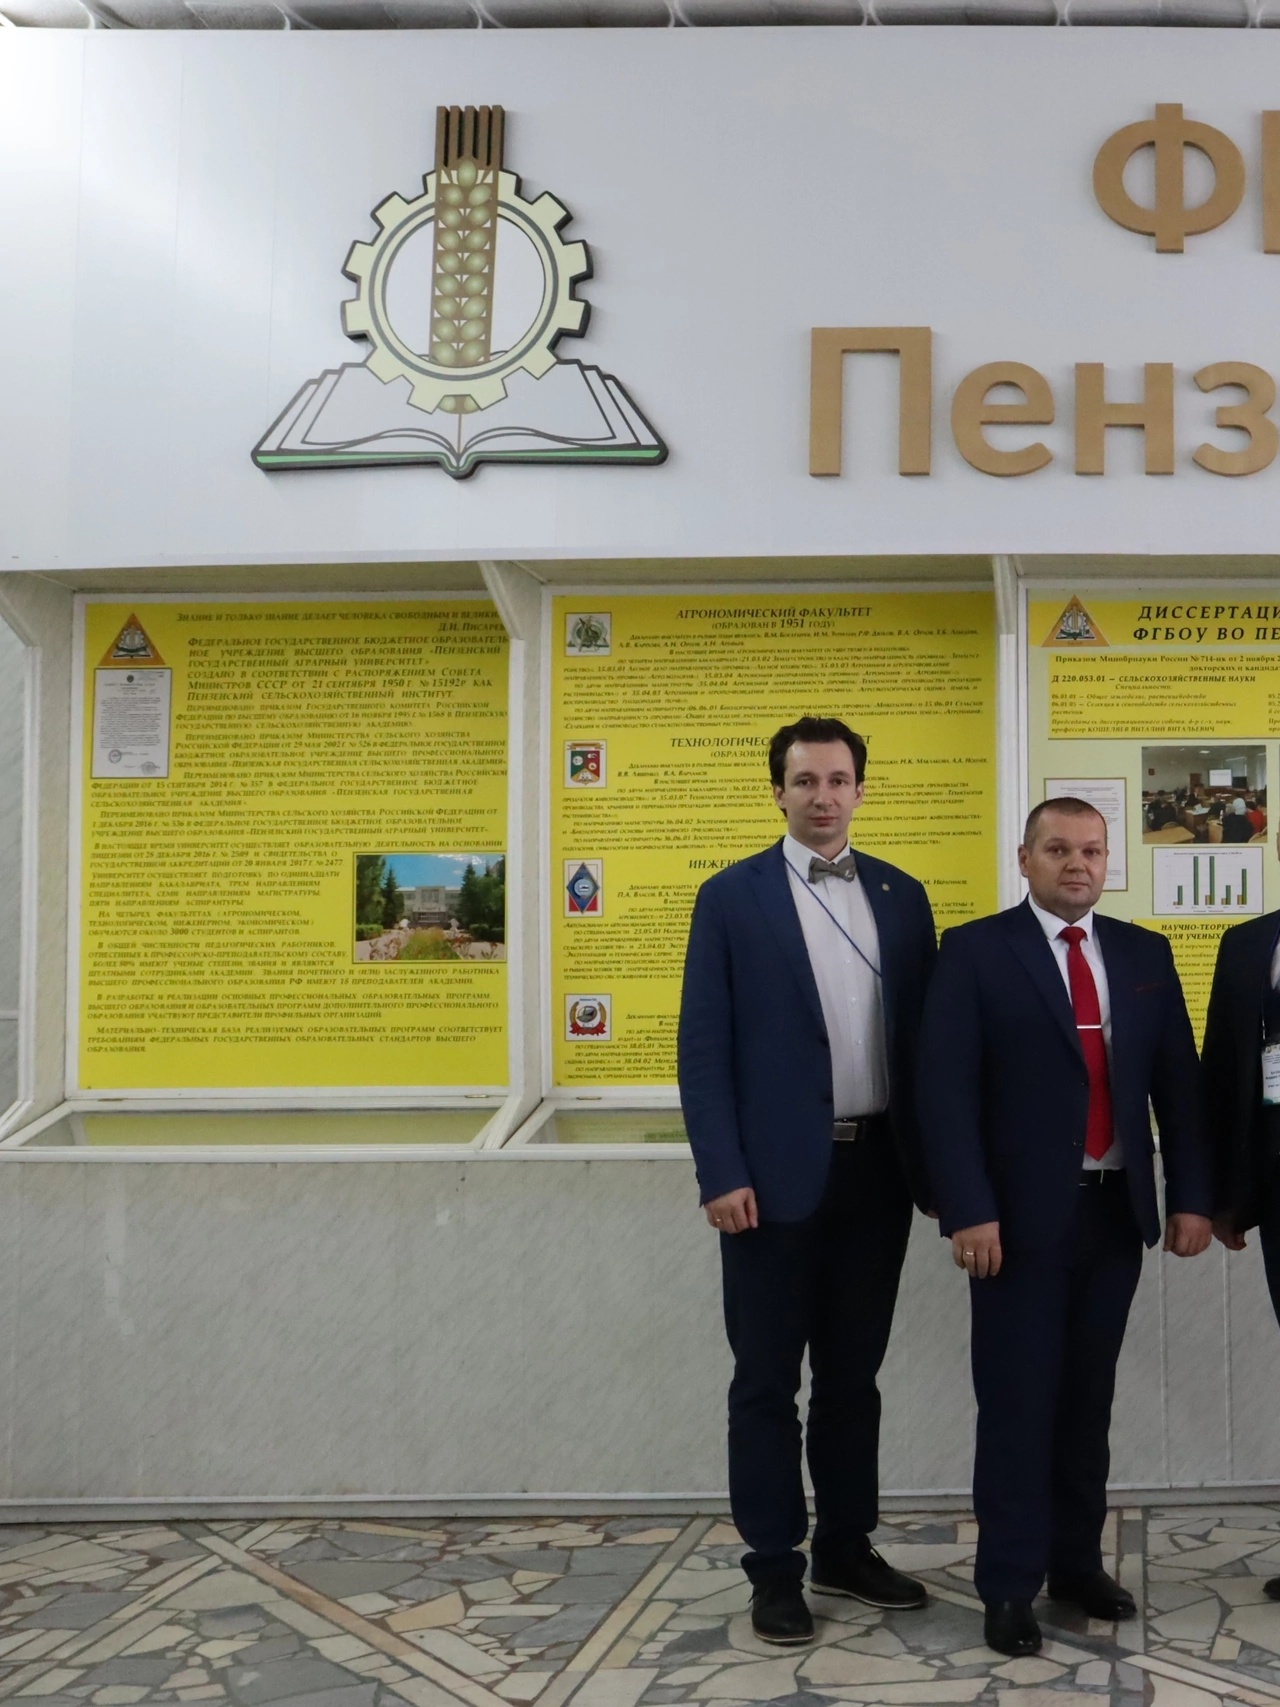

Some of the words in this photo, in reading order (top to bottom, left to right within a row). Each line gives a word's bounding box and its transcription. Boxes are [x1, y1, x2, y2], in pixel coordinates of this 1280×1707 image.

[677, 607, 796, 619] АГРОНОМИЧЕСКИЙ
[799, 607, 872, 618] ФАКУЛЬТЕТ
[781, 619, 804, 628] 1951
[1133, 627, 1207, 643] ФГБОУ
[1217, 627, 1244, 640] ВО
[188, 637, 261, 646] ФЕДЕРАЛЬНОЕ
[265, 637, 360, 646] ГОСУДАРСТВЕННОЕ
[364, 636, 428, 645] БЮДЖЕТНОЕ
[189, 649, 209, 658] НОЕ
[221, 648, 284, 657] УЧРЕЖДЕНИЕ
[294, 647, 343, 656] ВЫСШЕГО
[351, 646, 422, 656] ОБРАЗОВАНИЯ
[189, 659, 288, 668] ГОСУДАРСТВЕННЫЙ
[295, 658, 347, 667] АГРАРНЫЙ
[1056, 655, 1096, 664] Приказом
[1100, 655, 1157, 663] Минобрнауки
[1161, 655, 1188, 663] России
[1229, 655, 1237, 663] от
[187, 670, 235, 679] СОЗДАНО
[241, 670, 246, 679] В
[252, 669, 328, 678] СООТВЕТСТВИИ
[333, 669, 340, 678] С
[345, 668, 435, 677] РАСПОРЯЖЕНИЕМ
[442, 668, 480, 677] СОВЕТА
[188, 680, 251, 690] МИНИСТРОВ
[257, 680, 287, 689] СССР
[292, 680, 305, 689] ОТ
[312, 680, 322, 688] 21
[326, 679, 376, 688] СЕНТЯБРЯ
[383, 679, 404, 688] 1950
[473, 678, 492, 687] КАК
[1052, 675, 1059, 683] Д
[1062, 675, 1105, 683] 220.053.01
[1119, 675, 1226, 683] СЕЛЬСКОХОЗЯЙСТВЕННЫЕ
[1229, 675, 1255, 683] НАУКИ
[187, 691, 253, 701] ПЕНЗЕНСКИЙ
[262, 690, 394, 700] СЕЛЬСКОХОЗЯЙСТВЕННЫЙ
[671, 737, 769, 747] ТЕХНОЛОГИЧЕС
